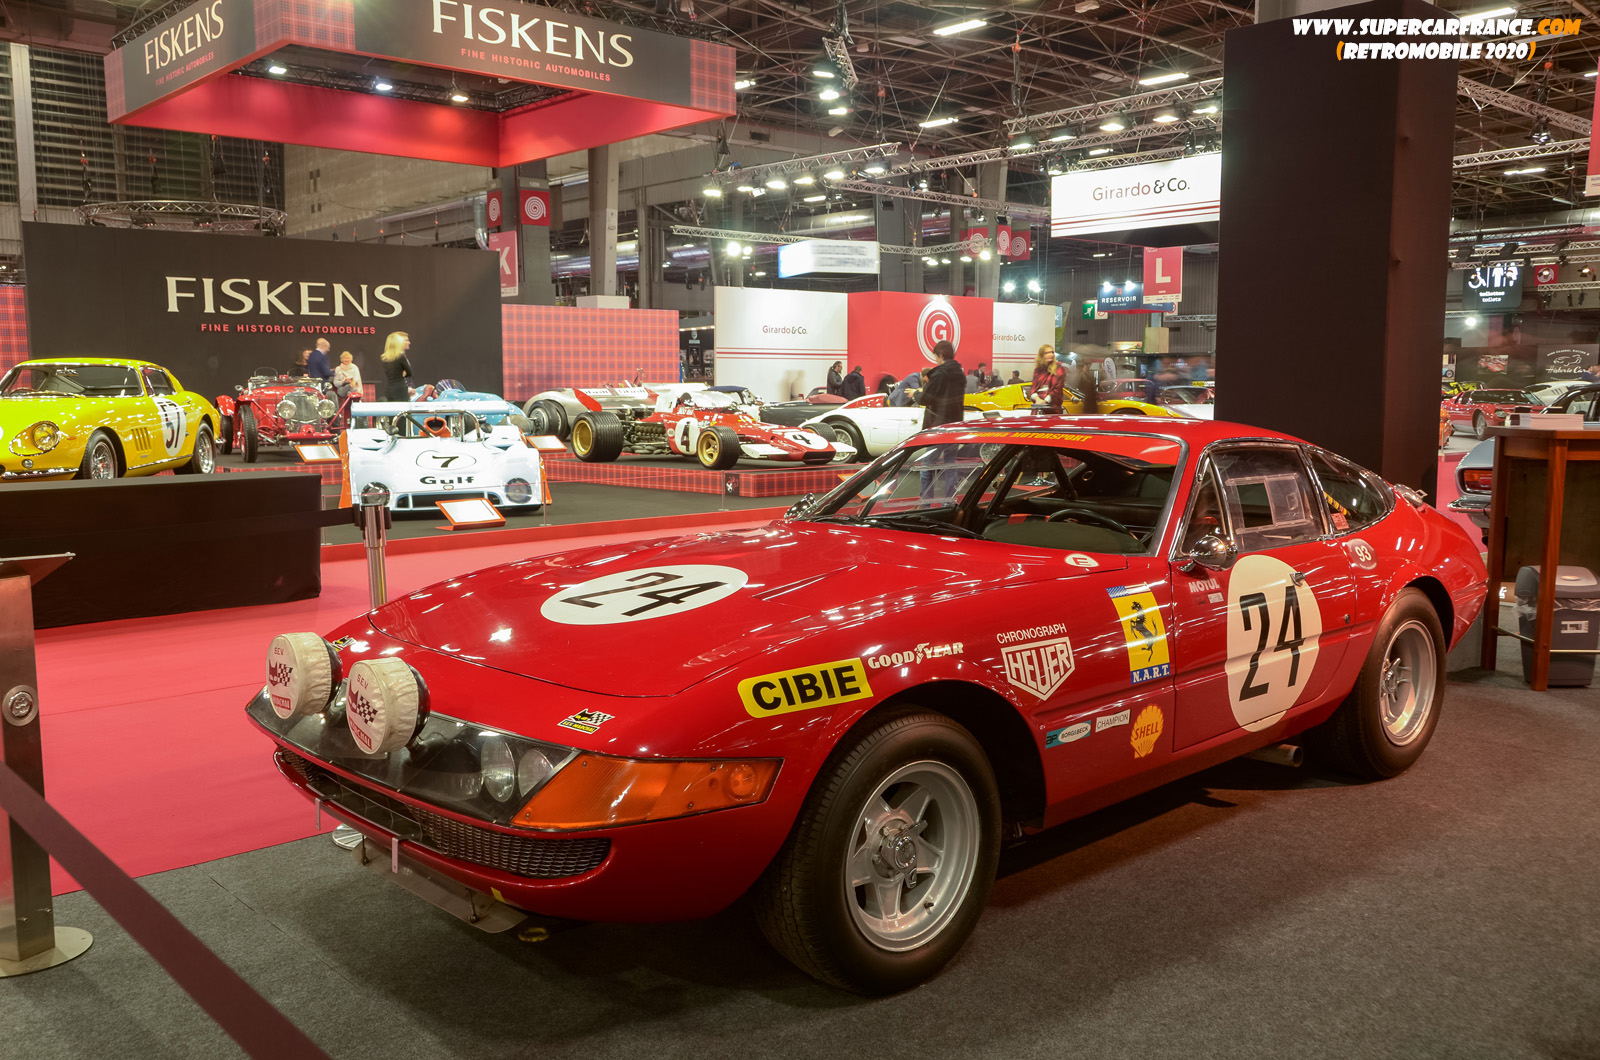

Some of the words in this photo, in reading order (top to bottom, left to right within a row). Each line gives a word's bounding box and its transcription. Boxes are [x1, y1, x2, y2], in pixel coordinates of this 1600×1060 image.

[144, 0, 224, 75] FISKENS
[432, 0, 634, 68] FISKENS
[166, 66, 185, 82] HISTORIC
[186, 51, 214, 72] AUTOMOBILES
[461, 48, 486, 60] FINE
[492, 54, 541, 70] HISTORIC
[546, 63, 611, 82] AUTOMOBILES
[496, 246, 512, 275] K
[1155, 257, 1172, 284] L
[165, 276, 404, 320] FISKENS
[1101, 295, 1137, 304] RESERVOIR
[200, 324, 230, 332] FINE
[237, 324, 294, 333] HISTORIC
[300, 326, 376, 334] AUTOMOBILES
[930, 319, 947, 341] G
[1546, 364, 1572, 374] Historic
[680, 421, 691, 452] 4
[792, 433, 811, 445] 4
[1013, 432, 1092, 442] MOTORSPORT
[432, 455, 460, 468] 7
[419, 475, 475, 486] Gulf
[1073, 556, 1090, 567] E
[1354, 546, 1372, 562] 93
[560, 572, 728, 617] 24
[1188, 578, 1220, 593] MOTUL
[996, 623, 1067, 644] CHRONOGRAPH
[1239, 585, 1306, 702] 24
[1007, 643, 1071, 694] HEUER
[1132, 664, 1170, 683] N.A.R.T.
[752, 665, 862, 711] CIBIE
[1096, 713, 1129, 730] CHAMPION
[1134, 722, 1160, 740] SHELL
